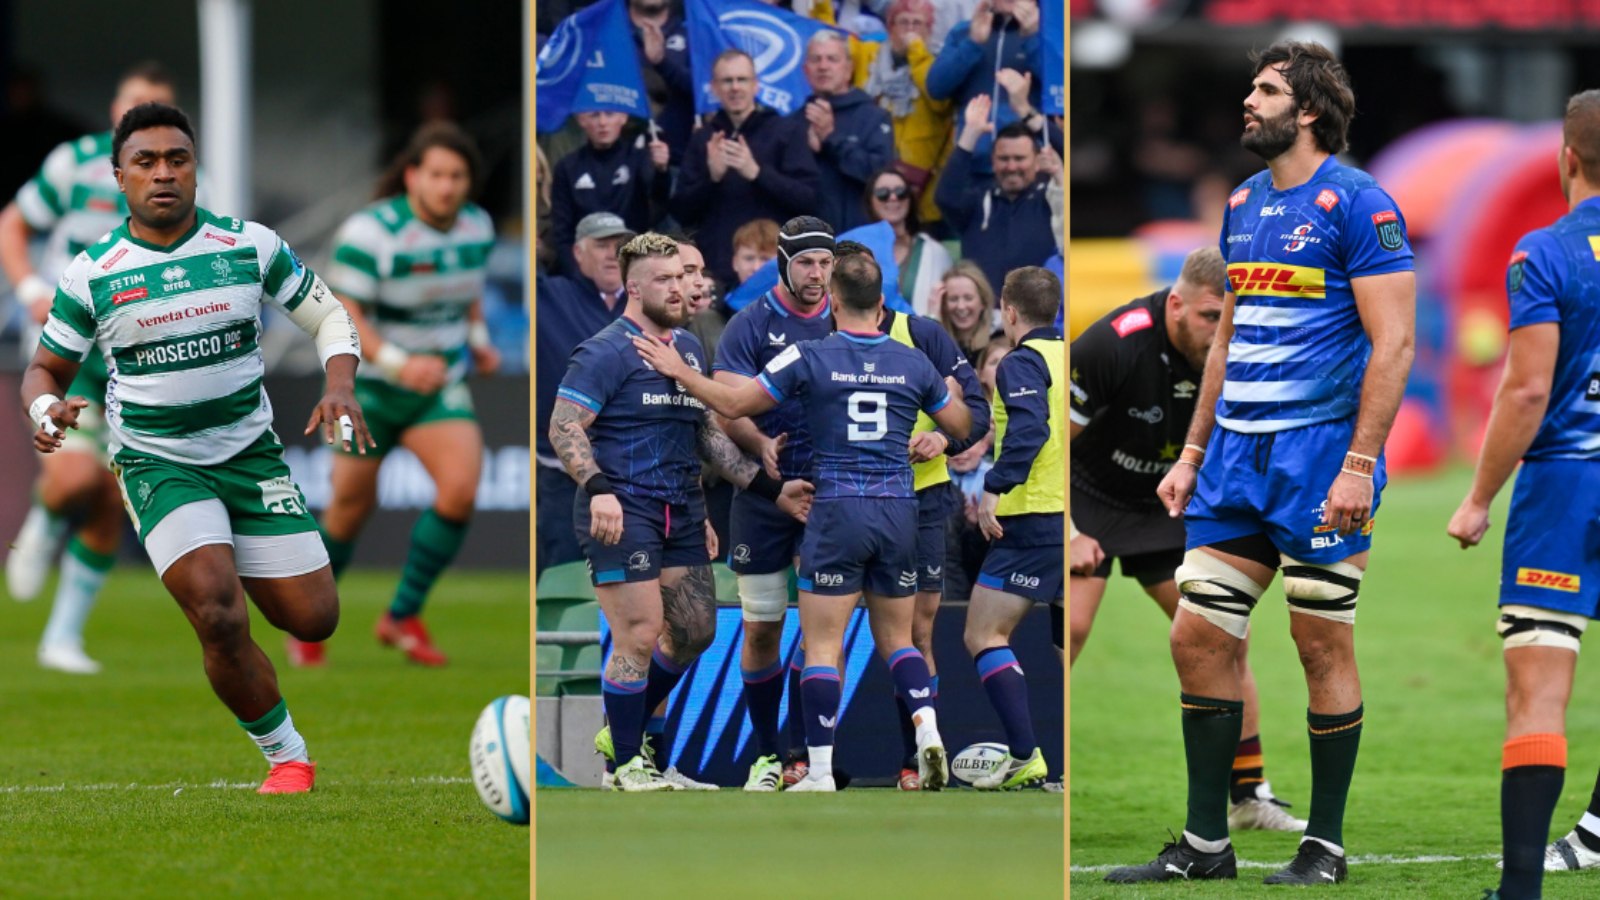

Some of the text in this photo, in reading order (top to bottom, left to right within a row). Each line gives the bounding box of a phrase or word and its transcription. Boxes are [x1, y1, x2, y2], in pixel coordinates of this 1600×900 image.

[1259, 205, 1287, 217] BLK
[122, 273, 146, 286] TIM
[1228, 267, 1302, 292] DHL
[136, 301, 231, 329] Veneta Cucine
[224, 330, 242, 344] DOC
[136, 335, 221, 367] PROSECCO
[831, 371, 905, 385] Bank of Ireland
[642, 392, 707, 409] Bank of Irela
[847, 392, 888, 441] 9
[1310, 533, 1344, 549] BLK
[815, 571, 844, 586] laya
[1010, 571, 1040, 588] laya
[1525, 570, 1573, 589] DHL
[952, 758, 998, 771] GILBE
